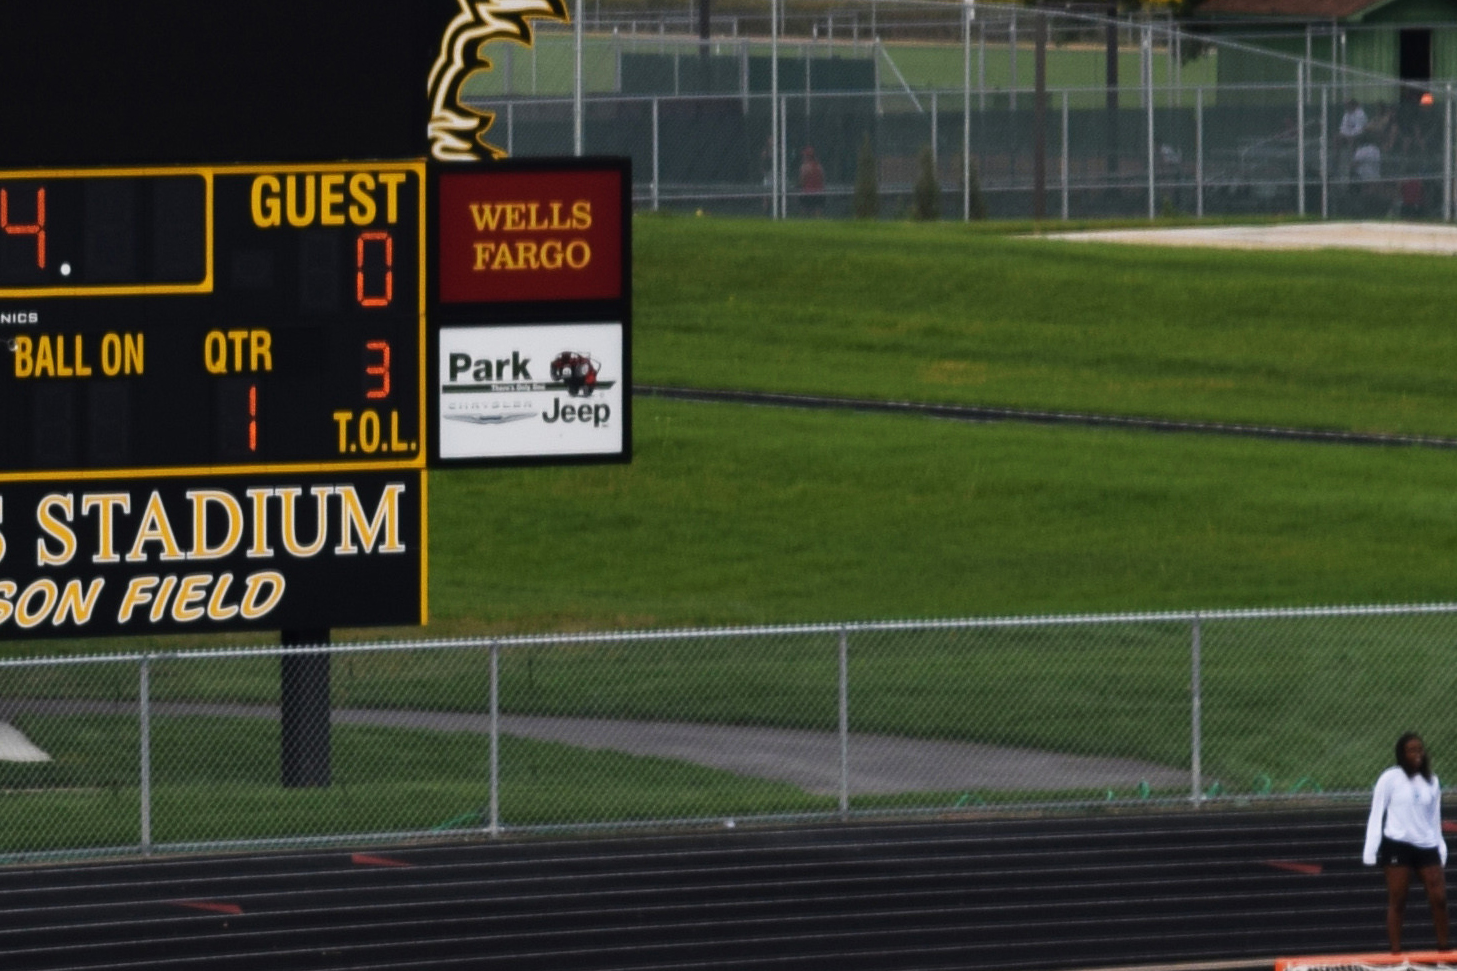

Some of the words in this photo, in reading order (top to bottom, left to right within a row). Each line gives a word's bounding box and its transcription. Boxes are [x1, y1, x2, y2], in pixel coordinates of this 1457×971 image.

[250, 173, 407, 227] GUEST
[469, 202, 592, 231] WELLS
[356, 231, 393, 307] 0
[473, 240, 591, 270] FARGO
[14, 335, 92, 378] BALL
[101, 333, 144, 375] ON
[204, 330, 273, 374] QTR
[366, 340, 391, 399] 3
[448, 352, 532, 382] Park
[248, 385, 258, 452] 1
[333, 410, 418, 454] T.O.L.
[542, 397, 611, 428] Jeep
[36, 484, 406, 567] STADIUM
[117, 571, 286, 625] FIELD
